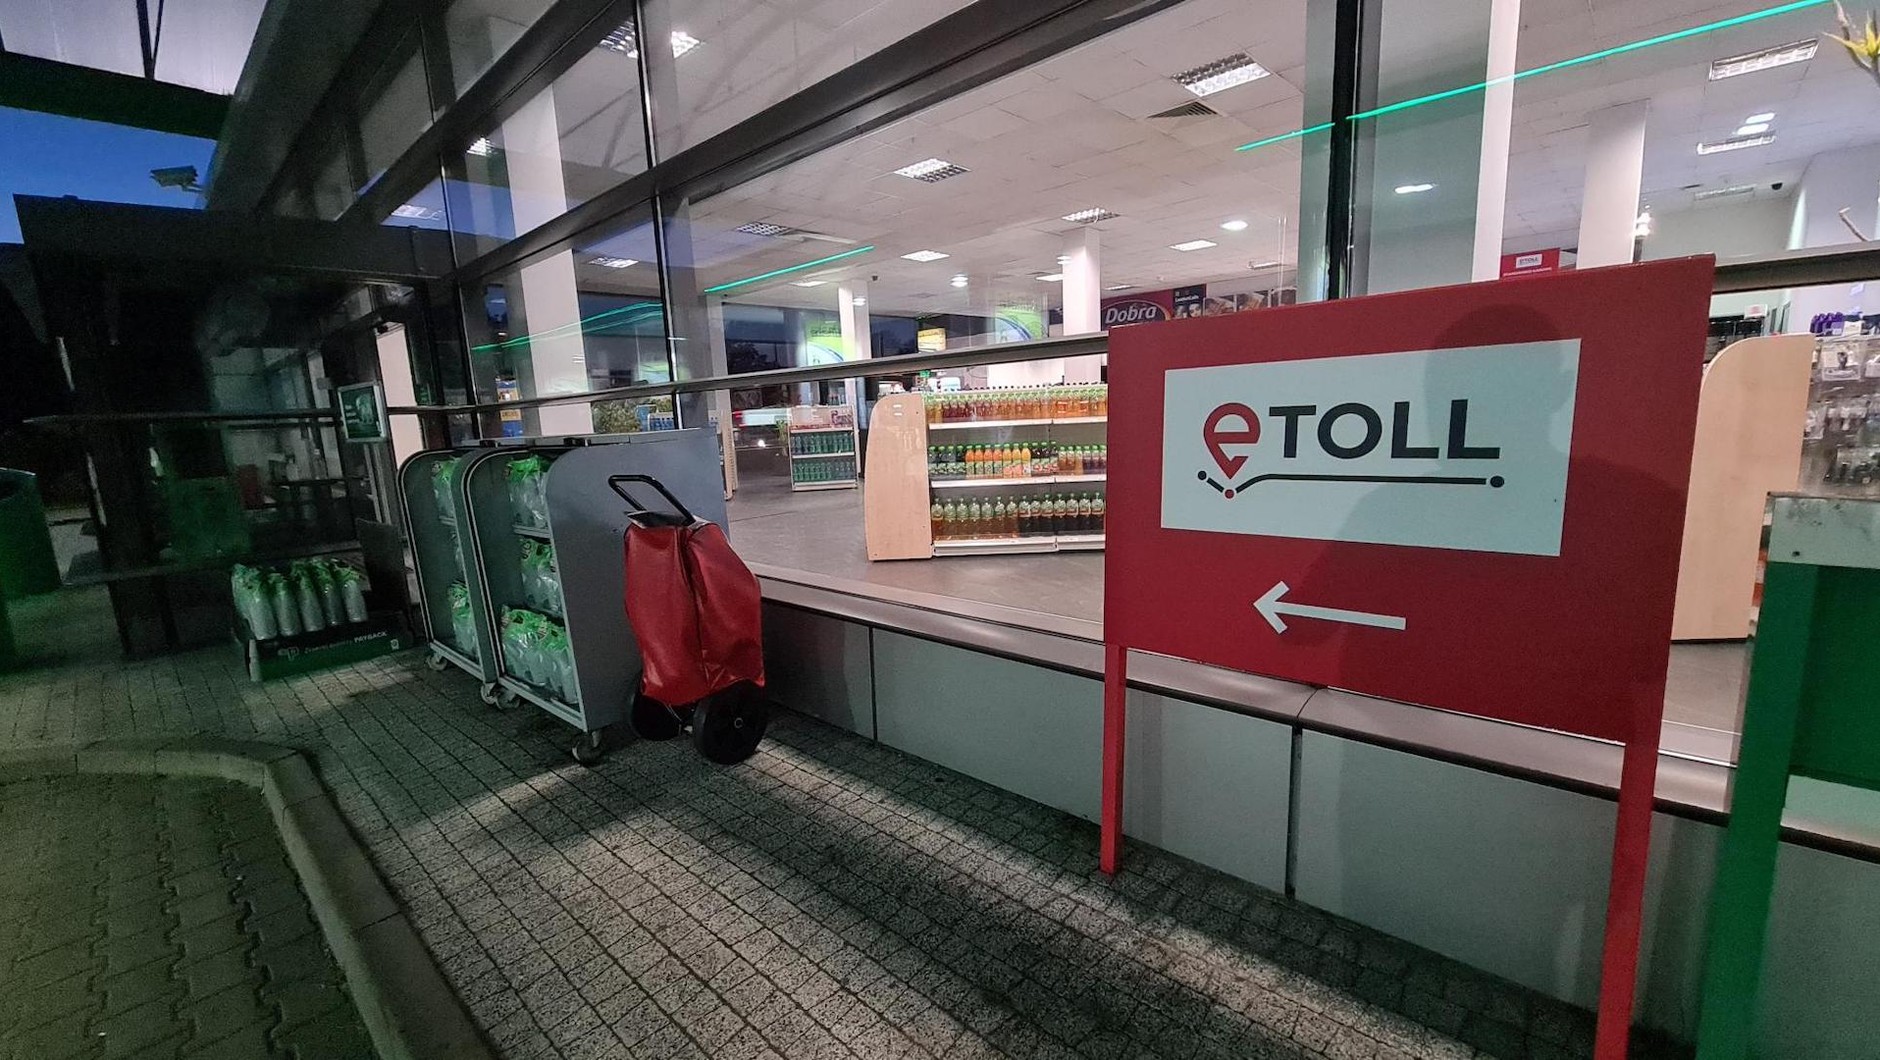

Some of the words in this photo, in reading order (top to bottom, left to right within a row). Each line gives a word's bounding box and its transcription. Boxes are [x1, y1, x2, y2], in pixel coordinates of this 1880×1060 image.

[1105, 306, 1157, 324] Dobra
[1203, 399, 1501, 480] eTOLL
[353, 631, 388, 643] PAYBACK
